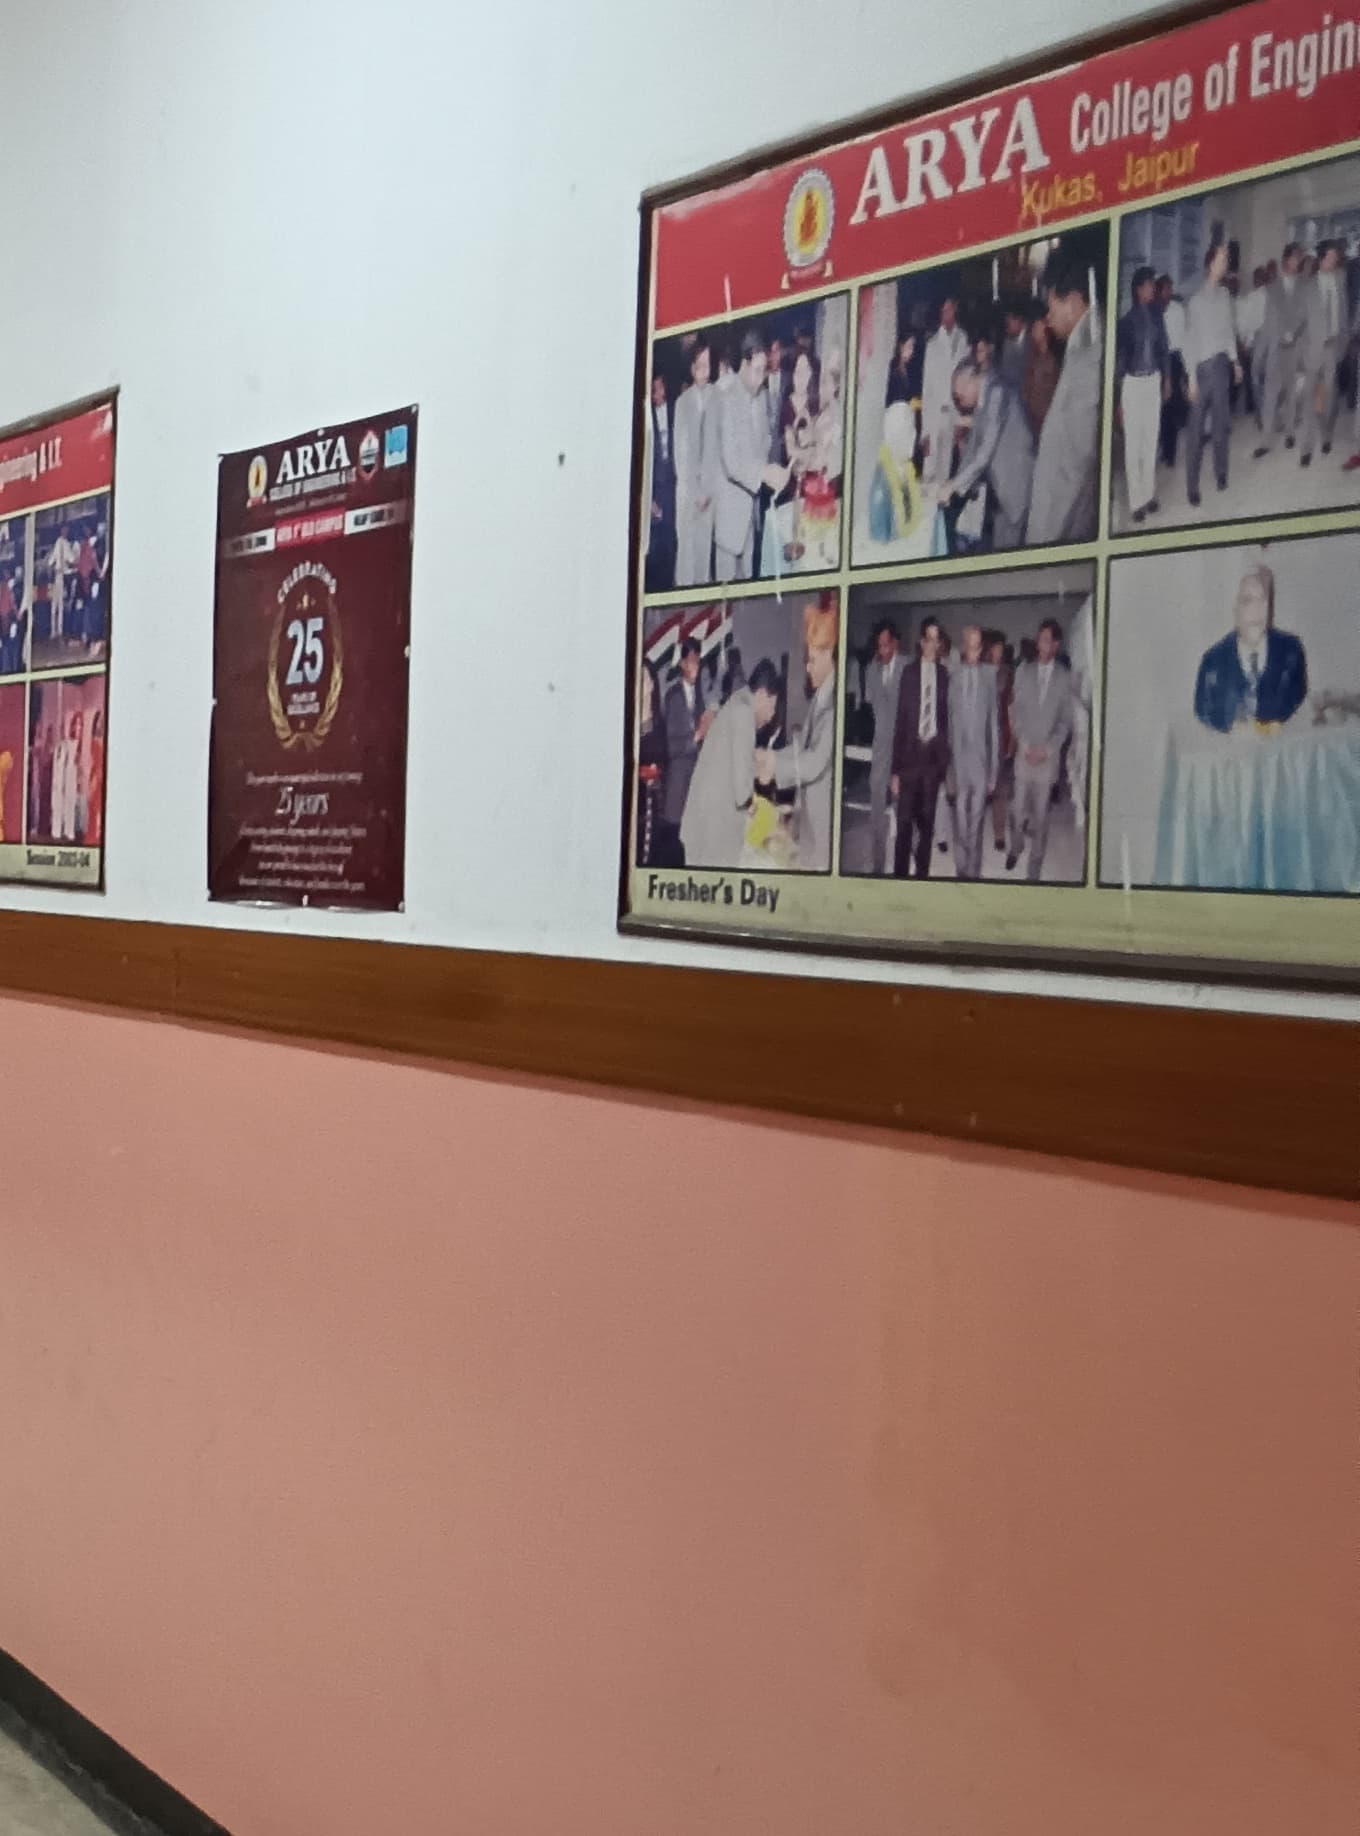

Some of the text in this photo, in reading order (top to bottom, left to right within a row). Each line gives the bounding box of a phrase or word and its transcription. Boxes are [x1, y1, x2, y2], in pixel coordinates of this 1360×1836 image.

[849, 14, 1360, 226] ARYA College of Engin
[1118, 142, 1200, 192] Jaipur
[276, 435, 352, 484] ARYA
[278, 560, 337, 604] CELEBRATING
[285, 616, 324, 685] 25
[648, 874, 780, 913] Fresher's Day
